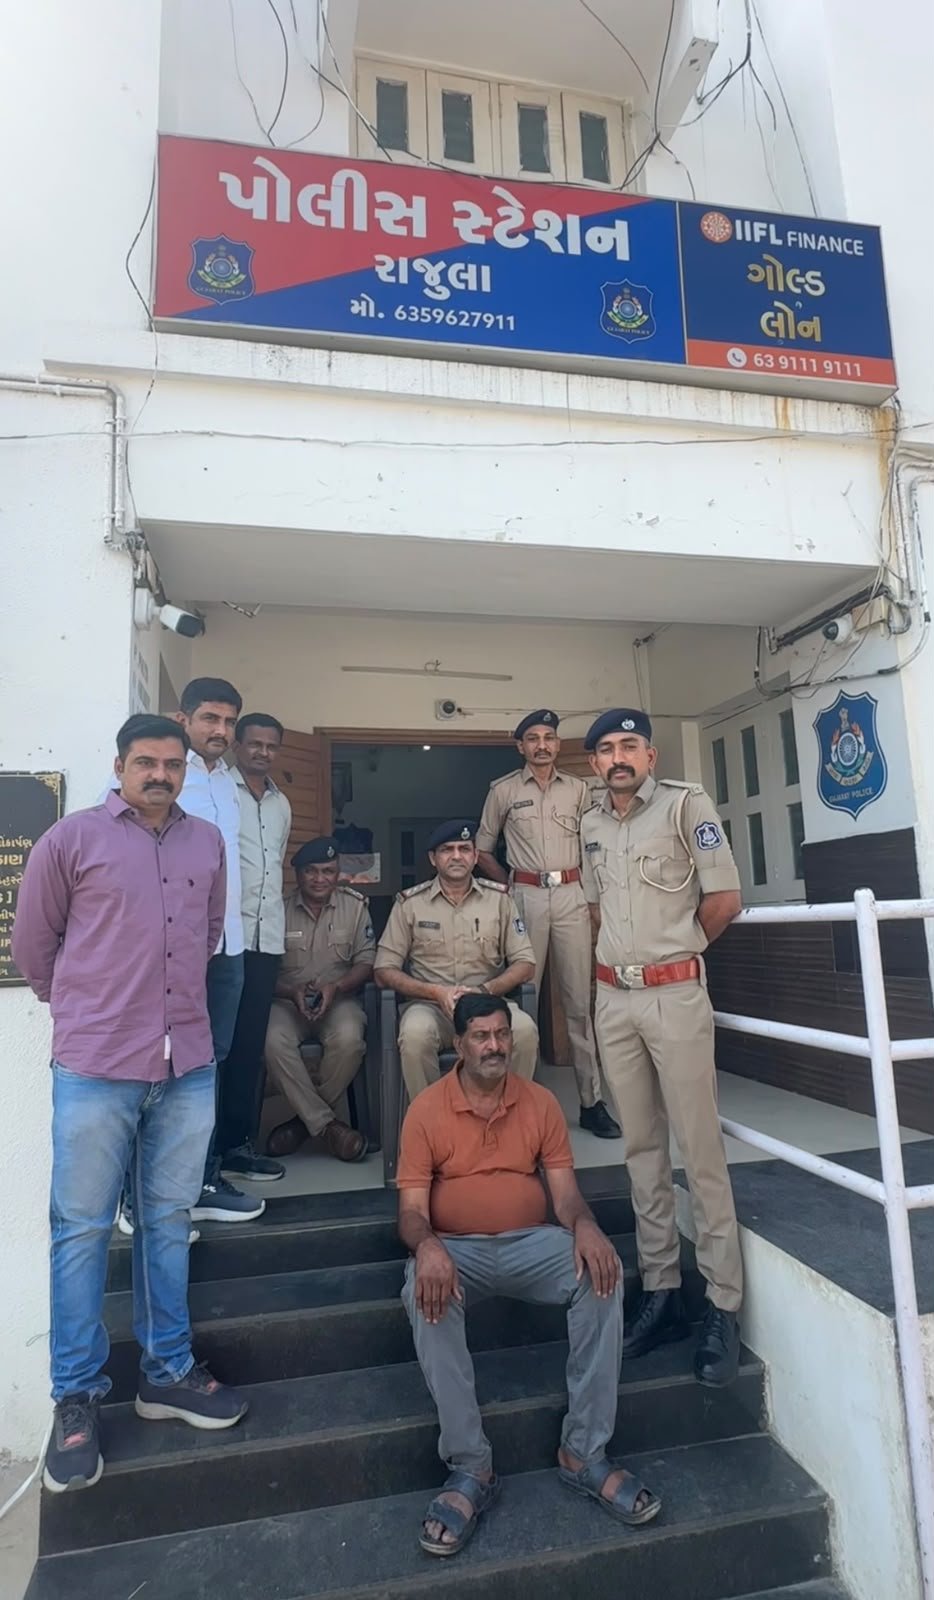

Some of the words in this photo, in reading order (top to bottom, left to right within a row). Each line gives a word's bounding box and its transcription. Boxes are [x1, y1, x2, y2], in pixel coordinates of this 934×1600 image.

[218, 156, 427, 238] પોલીસ
[452, 185, 631, 261] સ્ટેશન
[735, 219, 783, 246] IIFL
[787, 230, 864, 257] FINANCE
[373, 254, 491, 301] રાજુલા
[747, 253, 826, 297] ગોલ્ડ
[350, 293, 385, 319] મો.
[394, 304, 515, 331] 6359627911
[760, 300, 822, 343] લોન
[753, 353, 775, 369] 63
[778, 355, 818, 374] 9111
[823, 360, 862, 378] 9111
